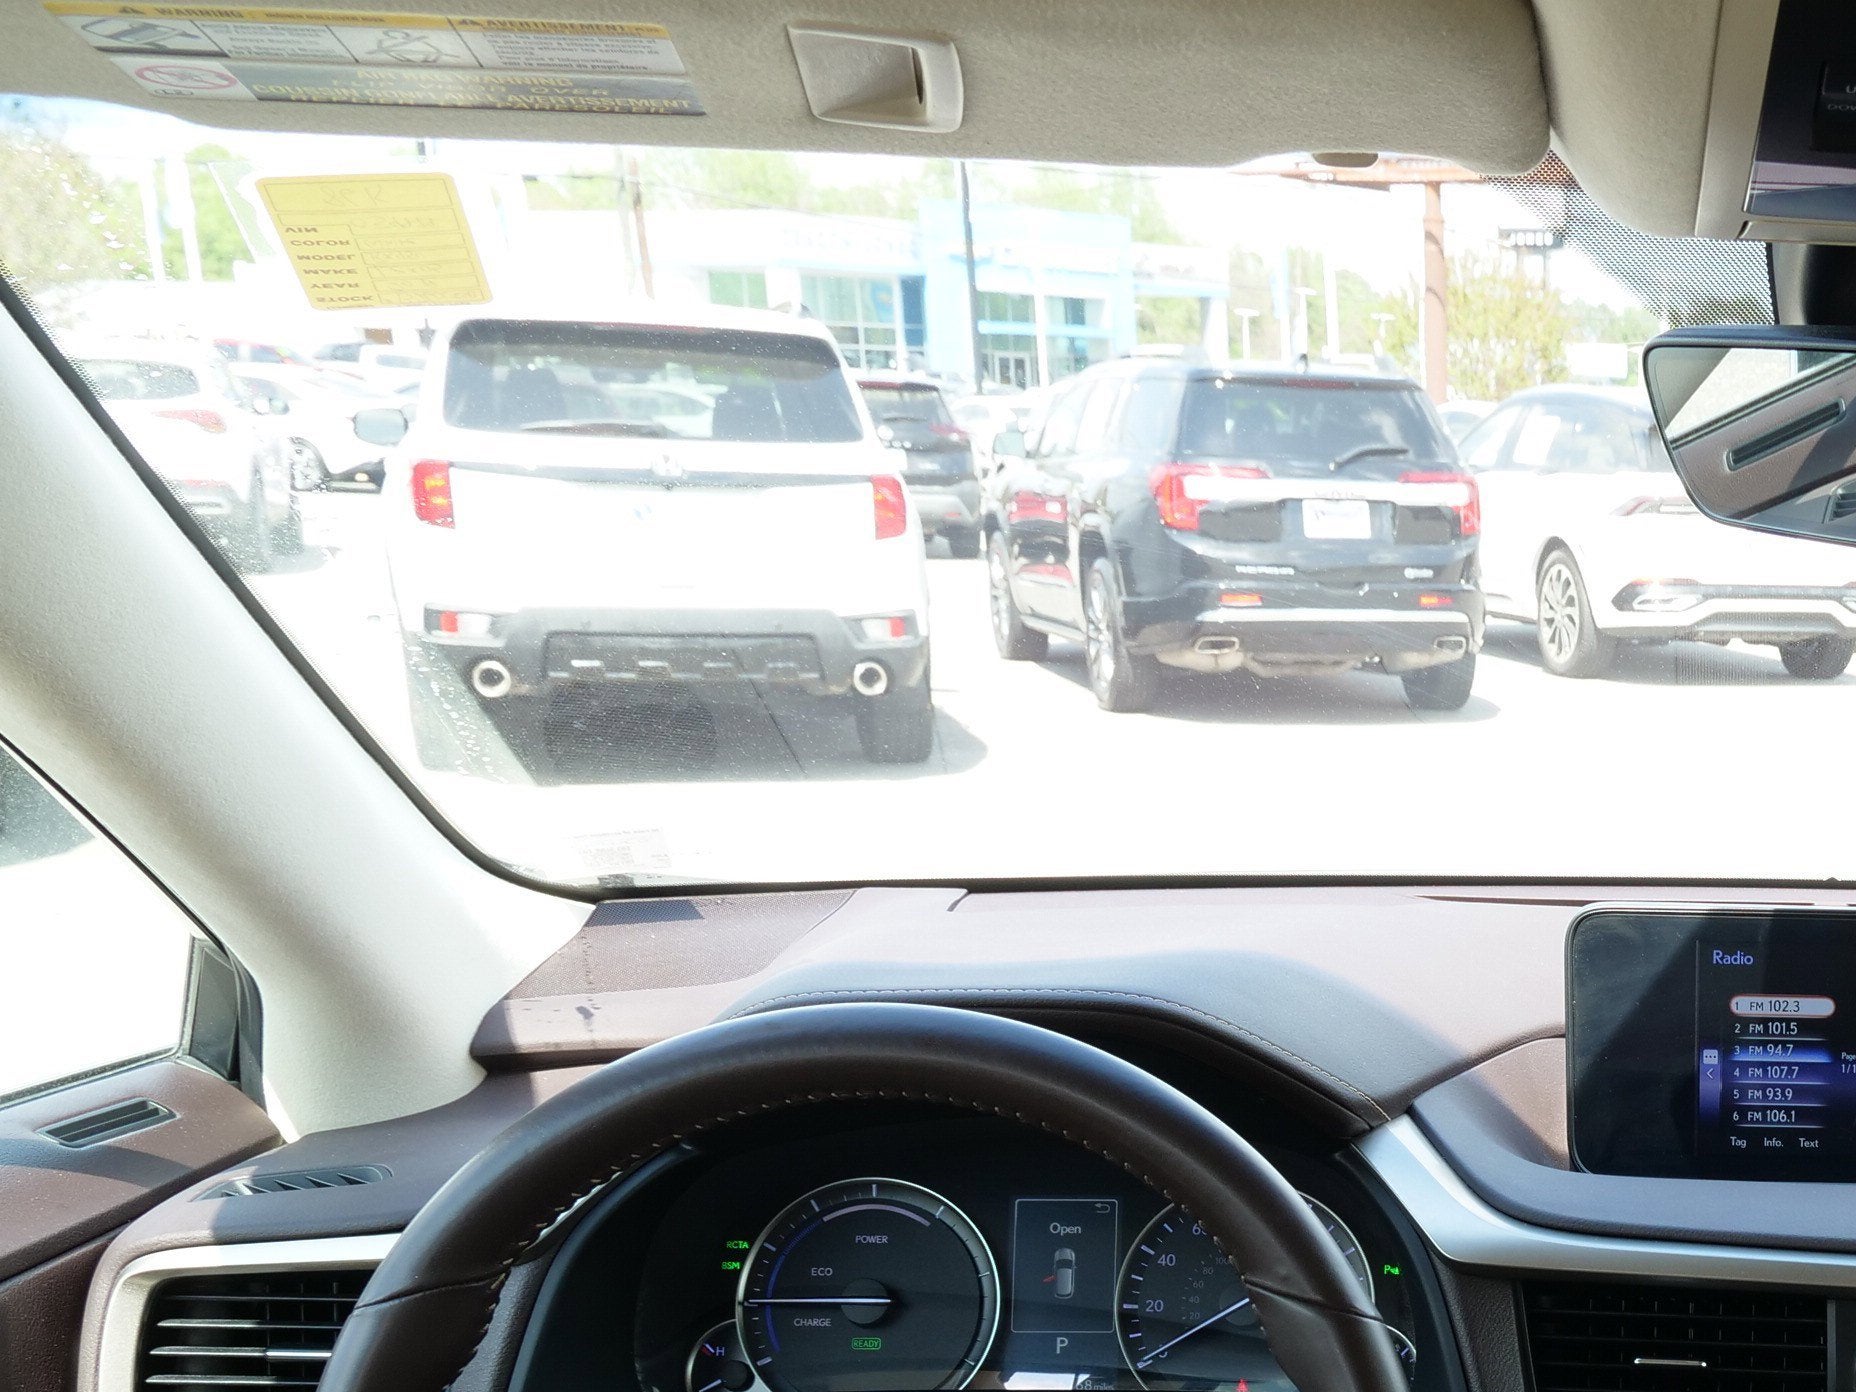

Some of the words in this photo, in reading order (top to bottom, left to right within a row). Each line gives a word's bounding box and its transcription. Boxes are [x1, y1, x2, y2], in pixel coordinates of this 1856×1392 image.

[1712, 949, 1754, 965] Radio
[1734, 1001, 1740, 1011] 1
[1749, 1001, 1764, 1012] FM
[1768, 1000, 1800, 1013] 102.3
[1734, 1023, 1741, 1034] 2
[1749, 1023, 1763, 1034] FM
[1768, 1022, 1798, 1035] 101.5
[1734, 1045, 1740, 1055] 3
[1748, 1045, 1763, 1056] FM
[1766, 1044, 1794, 1057] 94.7
[1841, 1052, 1856, 1061] Page
[1733, 1067, 1740, 1077] 4
[1748, 1067, 1763, 1078] FM
[1766, 1066, 1799, 1079] 107.7
[1841, 1064, 1856, 1074] 1/1
[1733, 1089, 1740, 1099] 5
[1748, 1089, 1762, 1100] FM
[1766, 1088, 1793, 1100] 93.9
[1733, 1111, 1739, 1121] 6
[1748, 1111, 1762, 1122] FM
[1766, 1110, 1795, 1123] 106.1
[1730, 1137, 1747, 1148] Tag
[1764, 1137, 1784, 1147] Info.
[1799, 1138, 1819, 1148] Text
[1050, 1223, 1082, 1236] Open
[726, 1240, 749, 1249] RCTA
[855, 1235, 888, 1244] POWER
[721, 1261, 741, 1270] BSM
[1157, 1254, 1176, 1267] 40
[811, 1267, 833, 1276] ECO
[1203, 1267, 1213, 1275] 80
[1192, 1281, 1204, 1289] 60
[1189, 1296, 1200, 1304] 40
[1146, 1300, 1164, 1313] 20
[793, 1318, 831, 1327] CHARGE
[853, 1339, 879, 1348] READY
[1056, 1337, 1069, 1354] P
[715, 1347, 725, 1357] H
